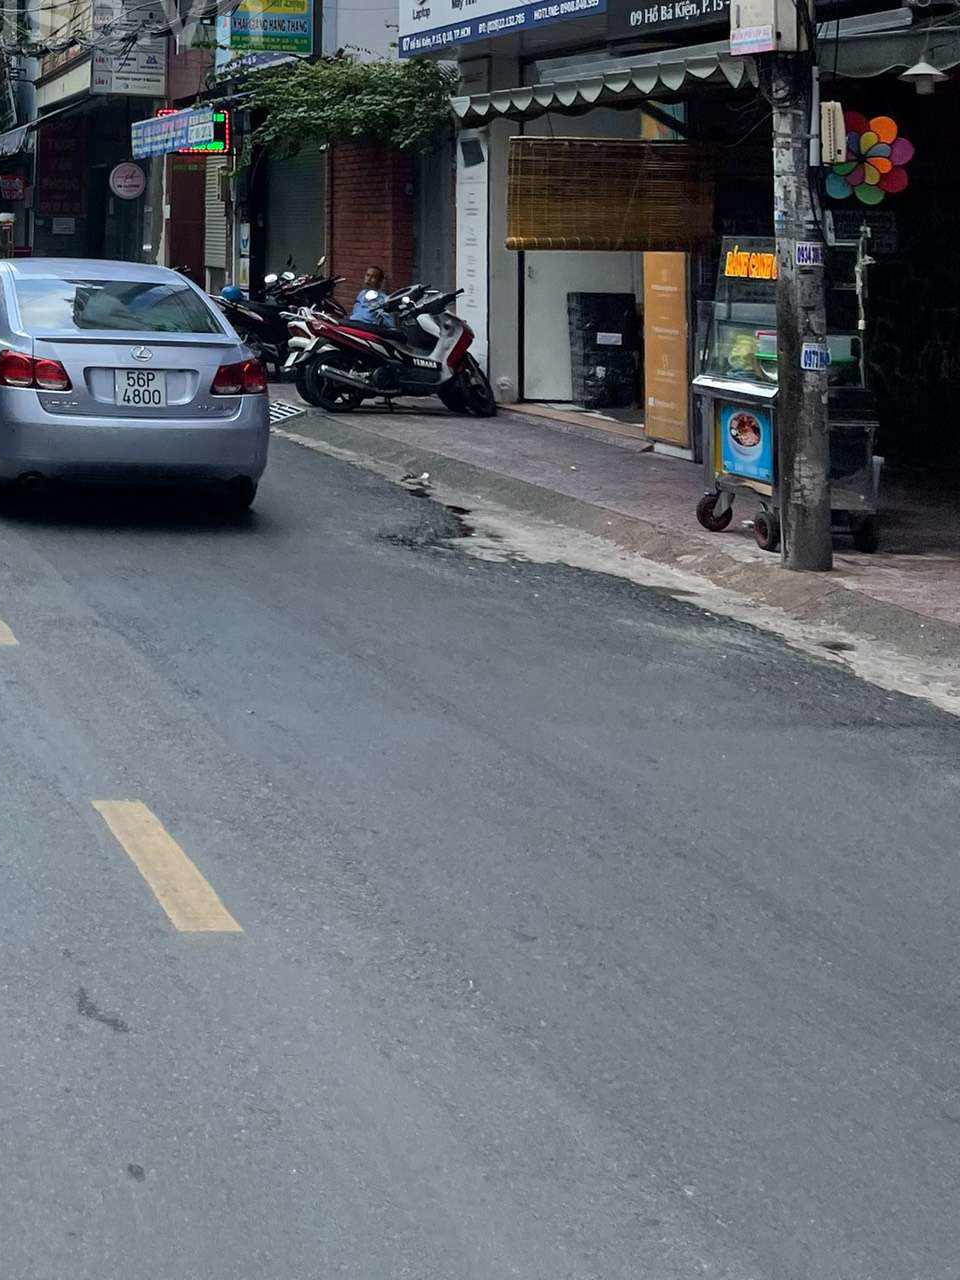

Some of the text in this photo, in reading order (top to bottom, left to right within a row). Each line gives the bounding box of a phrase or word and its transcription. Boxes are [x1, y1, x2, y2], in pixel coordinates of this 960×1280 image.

[412, 6, 431, 21] Laptop
[630, 10, 642, 26] 09
[644, 4, 659, 23] Hồ
[660, 3, 673, 21] Bá
[675, 0, 700, 21] Kiện,
[126, 371, 156, 388] 56P
[122, 389, 161, 405] 4800
